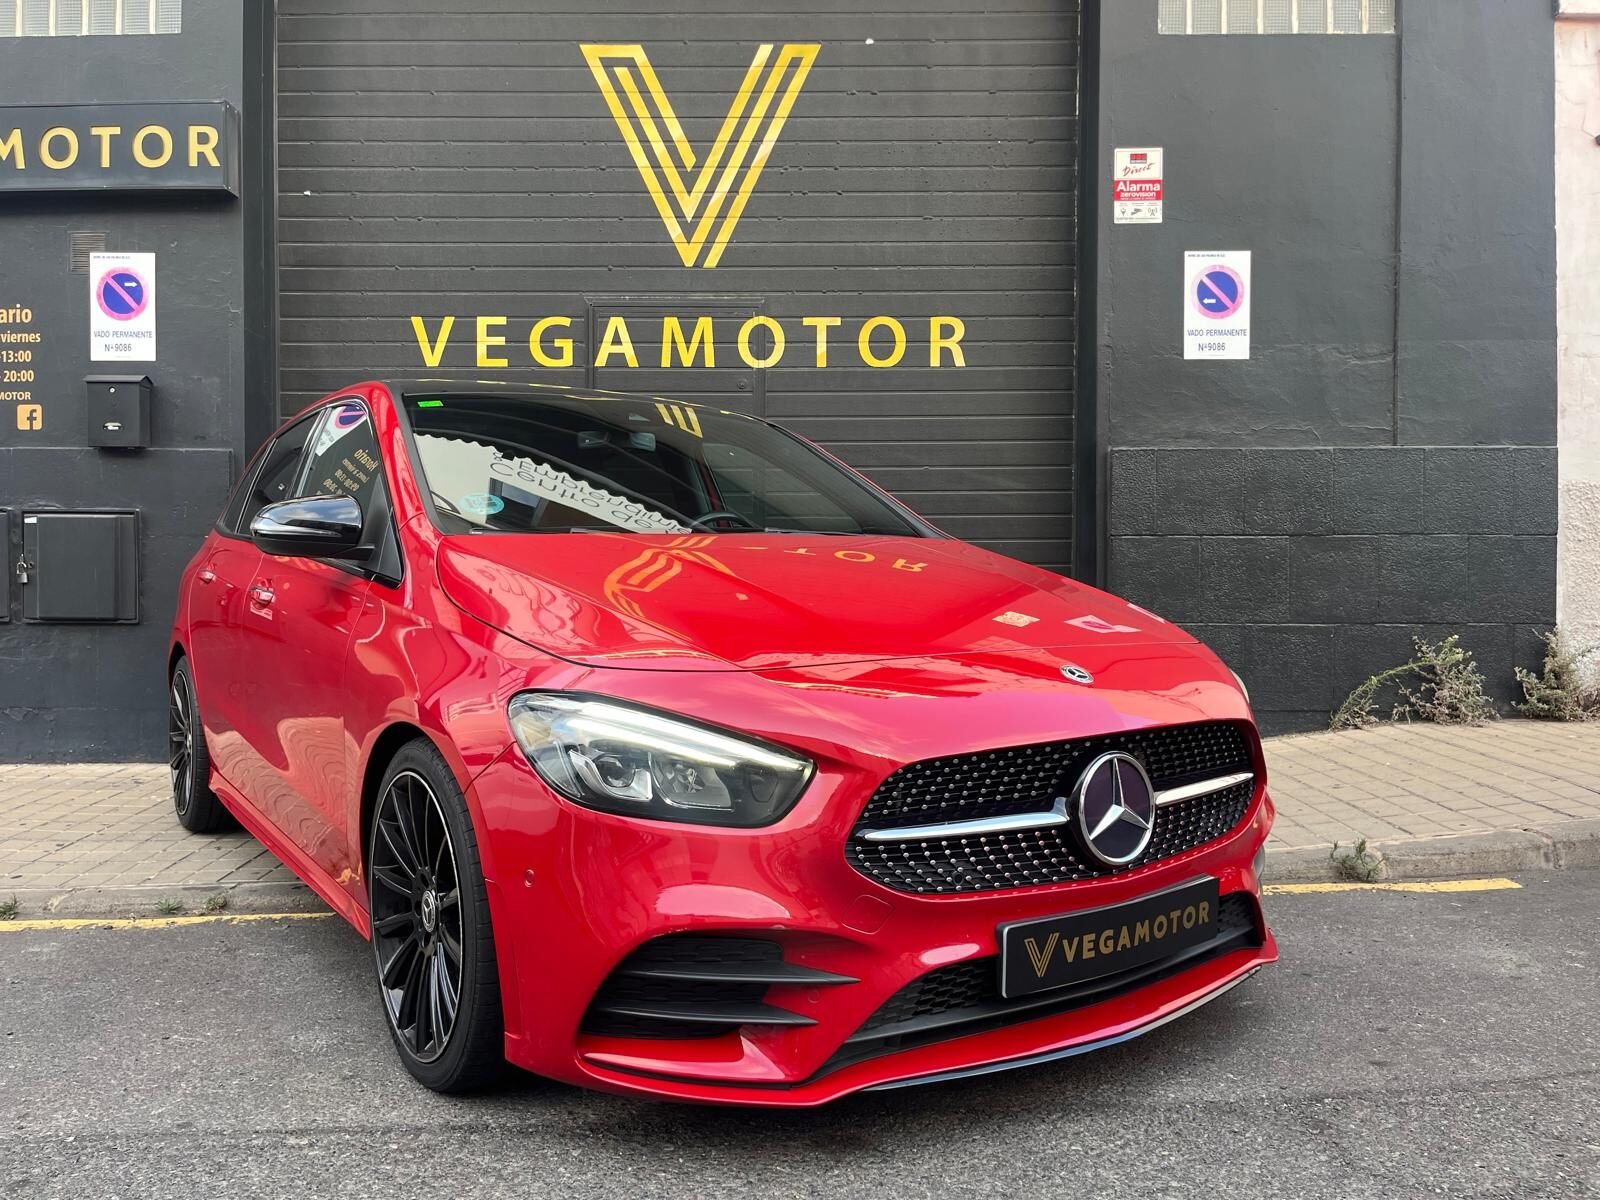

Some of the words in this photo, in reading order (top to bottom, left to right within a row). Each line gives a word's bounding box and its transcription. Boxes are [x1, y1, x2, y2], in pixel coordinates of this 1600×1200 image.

[1116, 181, 1161, 192] Alarma
[0, 330, 41, 343] viernes
[93, 330, 110, 338] VADO
[112, 330, 153, 339] PERMANENTE
[1187, 328, 1204, 337] VADO
[1205, 328, 1248, 337] PERMANENTE
[410, 316, 967, 369] VEGAMOTOR
[3, 369, 35, 382] 20:00
[1062, 900, 1210, 963] VEGAMOTOR
